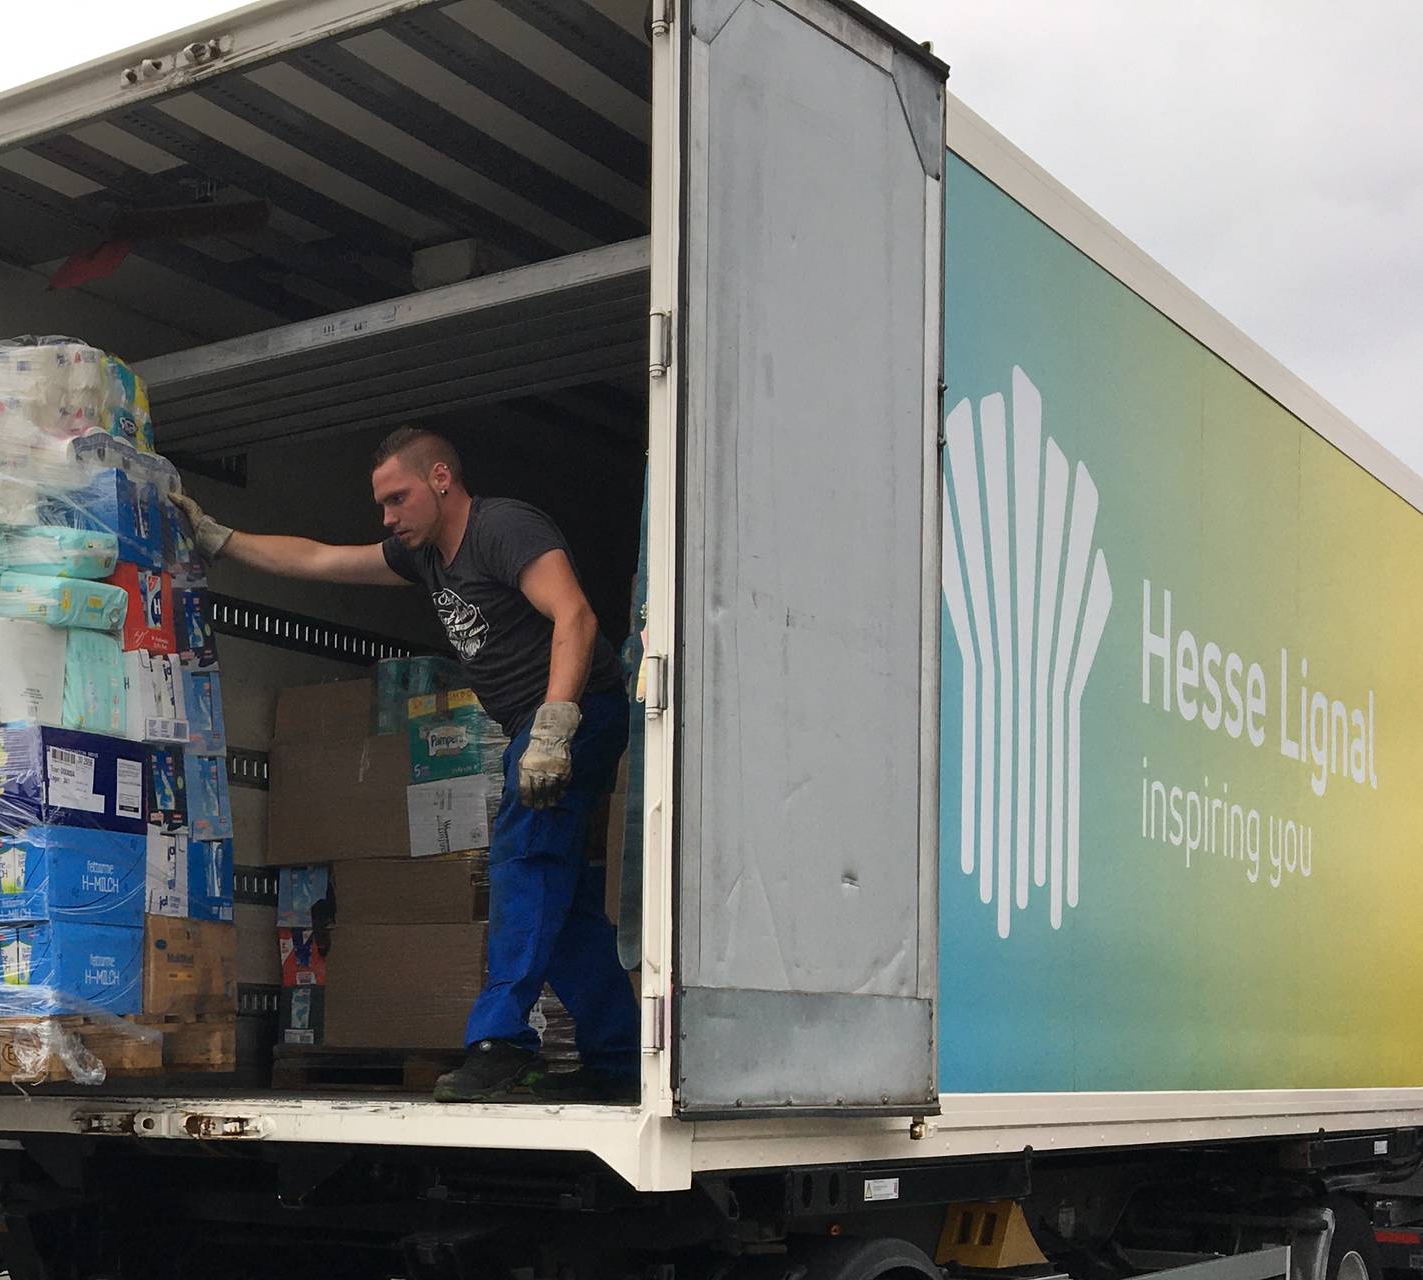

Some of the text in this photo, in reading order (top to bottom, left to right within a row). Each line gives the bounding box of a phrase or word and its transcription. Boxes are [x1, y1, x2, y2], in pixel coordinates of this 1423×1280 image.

[1142, 579, 1378, 796] Hesse Lignal
[431, 732, 465, 748] Pampers
[1142, 756, 1312, 888] inspiring you
[82, 875, 120, 893] H-MILCH
[85, 968, 120, 985] H-MILCH
